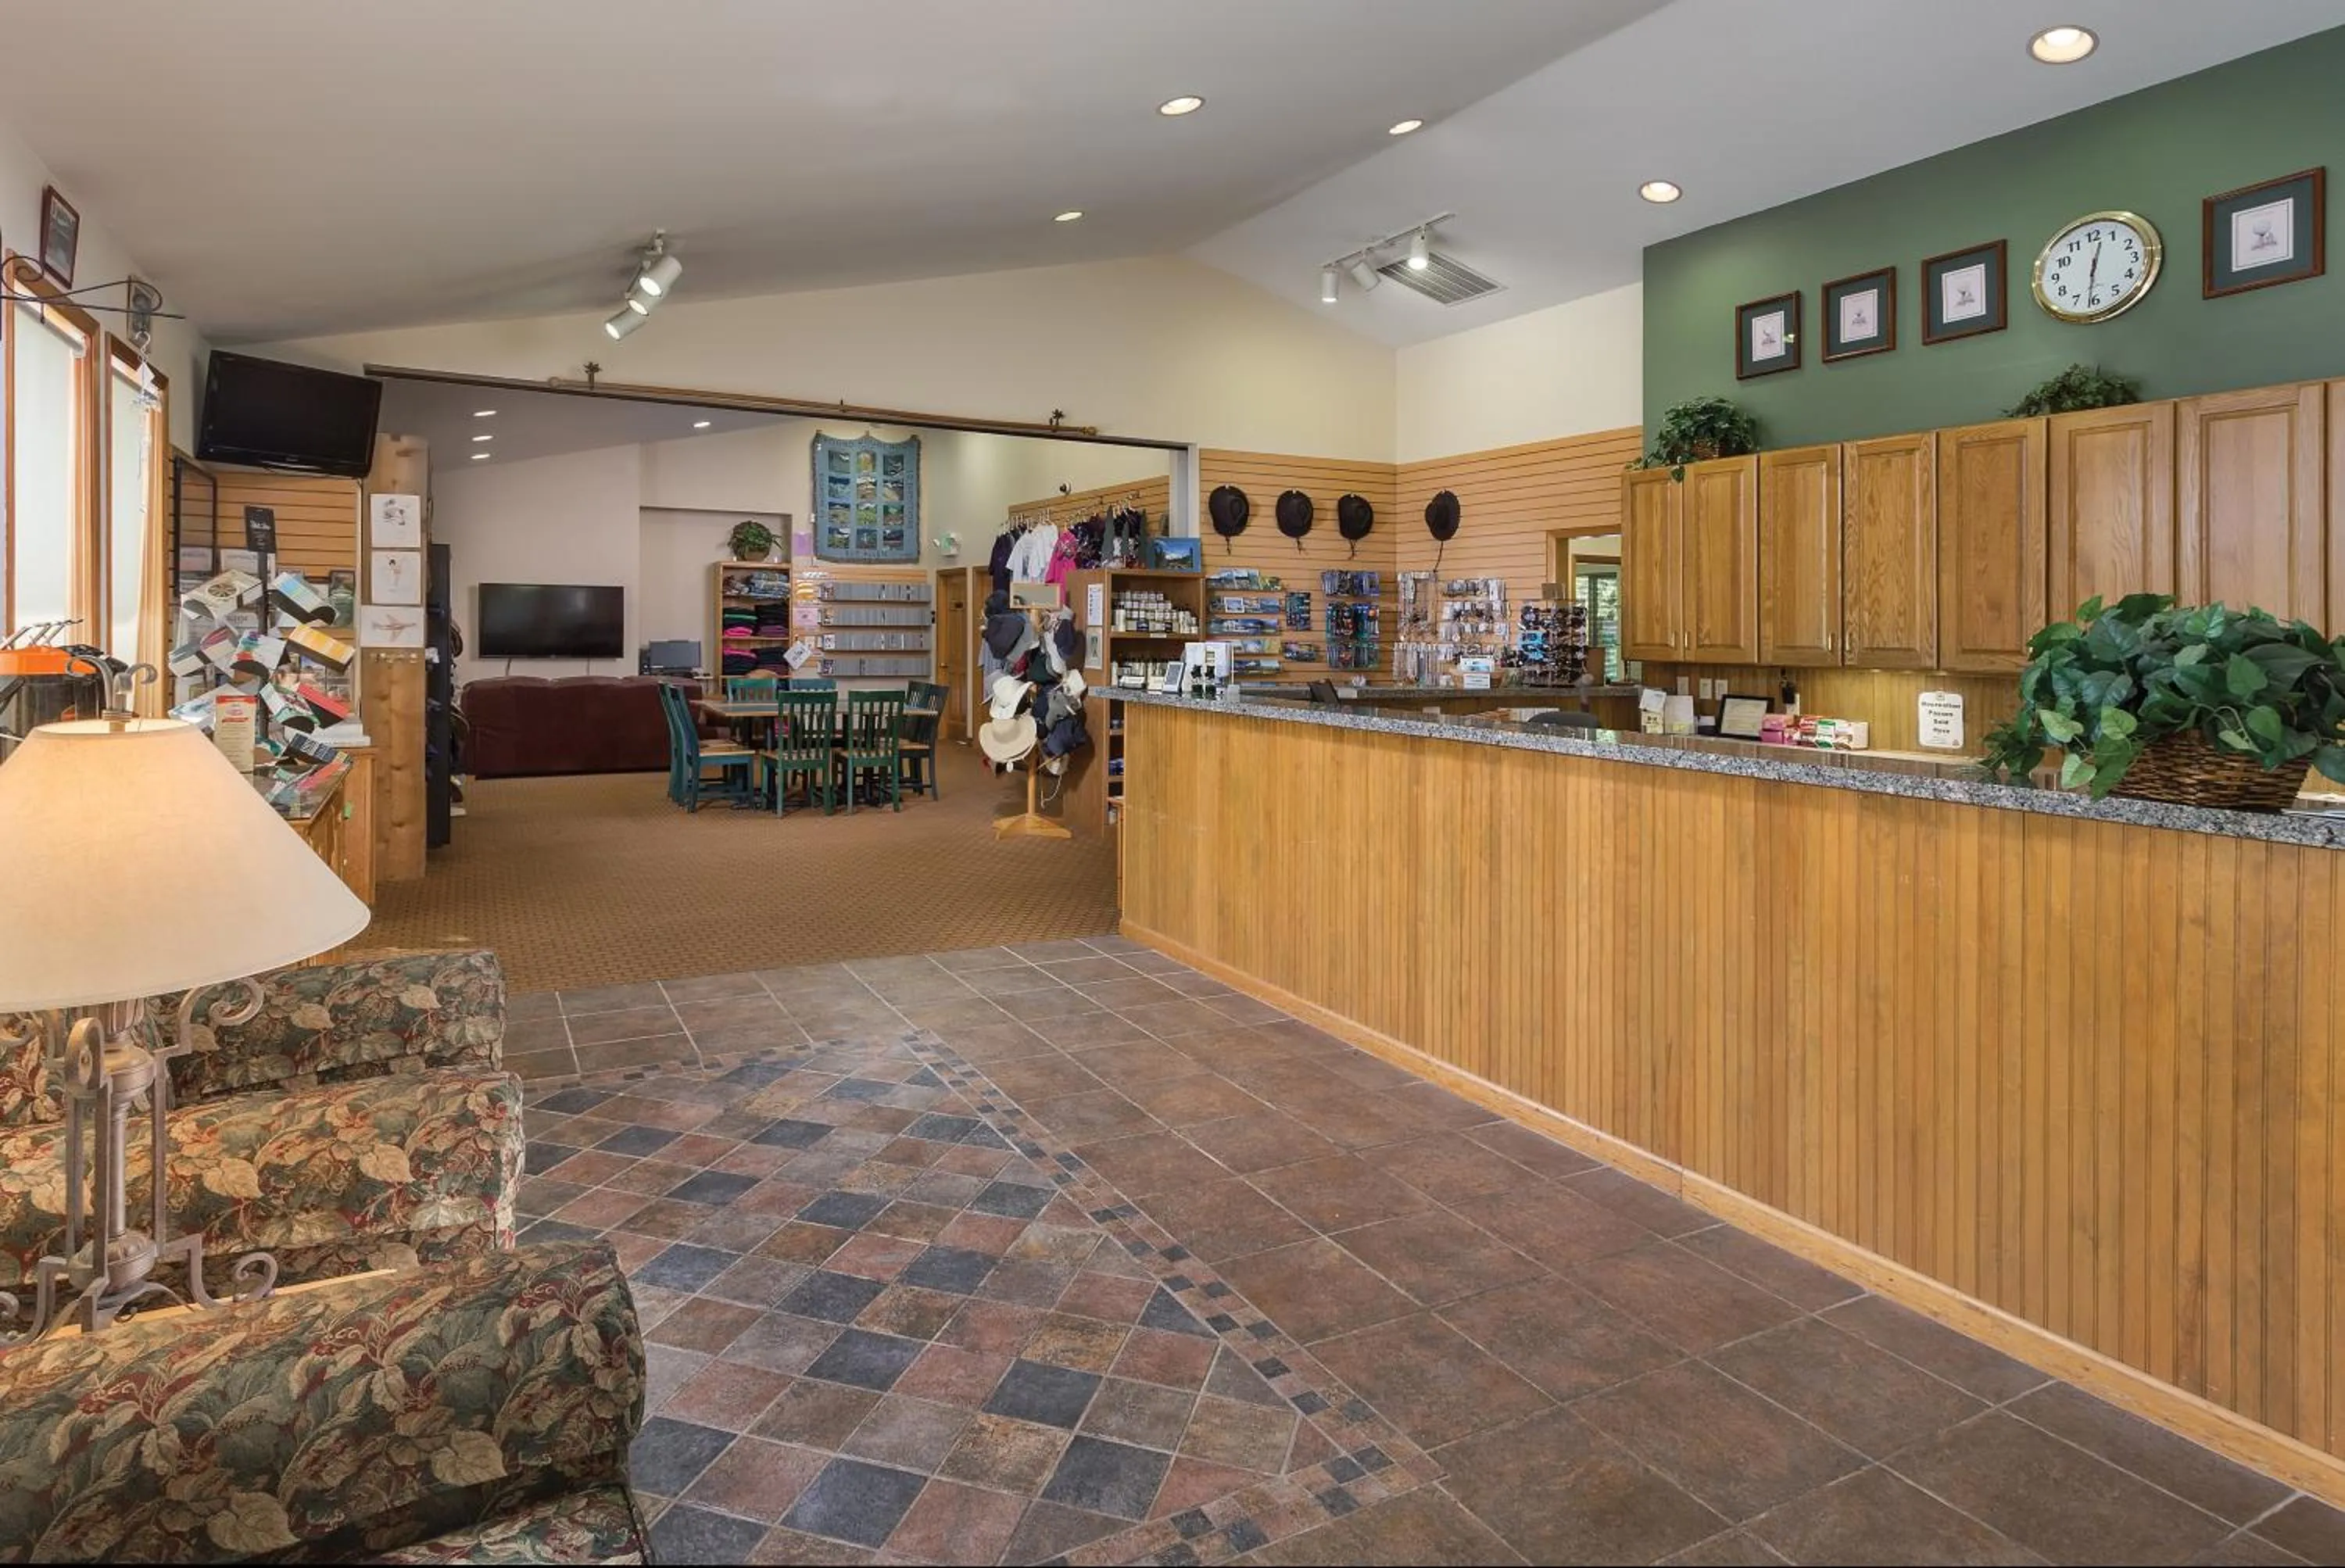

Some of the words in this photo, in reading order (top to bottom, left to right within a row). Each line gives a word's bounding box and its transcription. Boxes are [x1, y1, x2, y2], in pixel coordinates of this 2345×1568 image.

[2085, 229, 2101, 242] 12
[2108, 231, 2117, 242] 1
[2068, 241, 2080, 252] 11
[2124, 238, 2132, 251] 2
[2057, 256, 2071, 268] 10
[2130, 251, 2139, 263] 3
[2051, 273, 2060, 285] 9
[2125, 268, 2133, 279] 4
[2058, 285, 2067, 297] 8
[2111, 284, 2120, 296] 5
[2072, 294, 2080, 306] 7
[2092, 294, 2100, 306] 6
